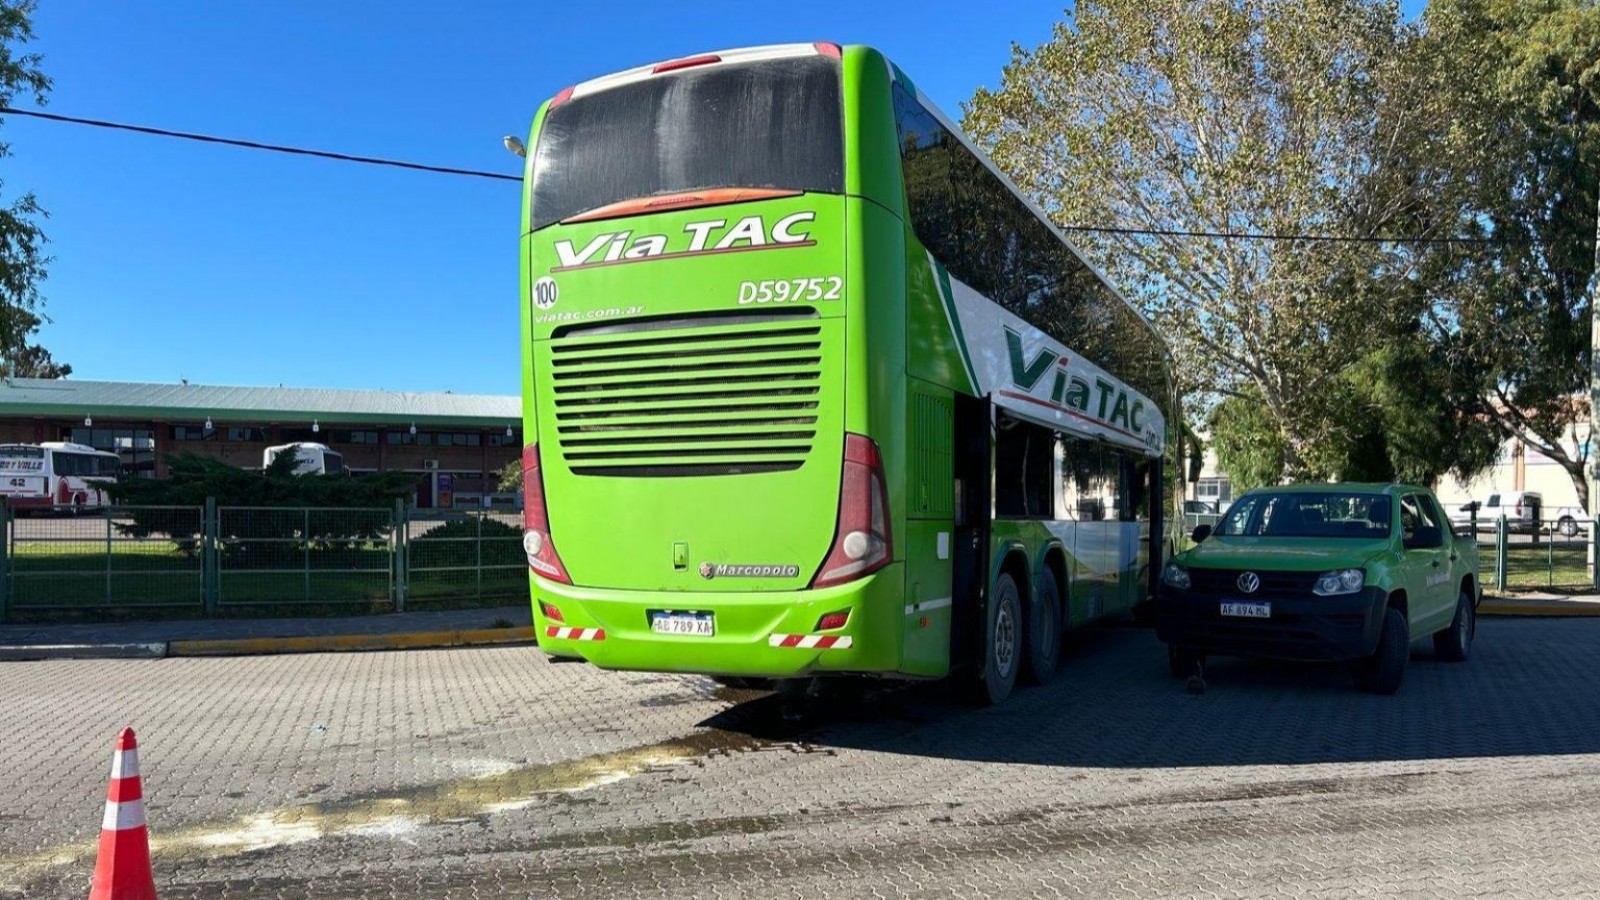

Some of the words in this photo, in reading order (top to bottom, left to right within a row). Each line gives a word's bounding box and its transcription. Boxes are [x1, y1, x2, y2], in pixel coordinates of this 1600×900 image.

[553, 228, 669, 269] Via
[683, 210, 817, 252] TAC
[535, 281, 557, 305] 100
[738, 276, 844, 306] D59752
[535, 304, 646, 324] viatac.com.ar
[1003, 324, 1090, 413] Via
[1096, 375, 1145, 433] TAC
[10, 478, 26, 487] 42
[716, 564, 796, 577] Marcopolo
[656, 619, 670, 632] AB
[673, 620, 693, 632] 789
[696, 620, 711, 633] XA
